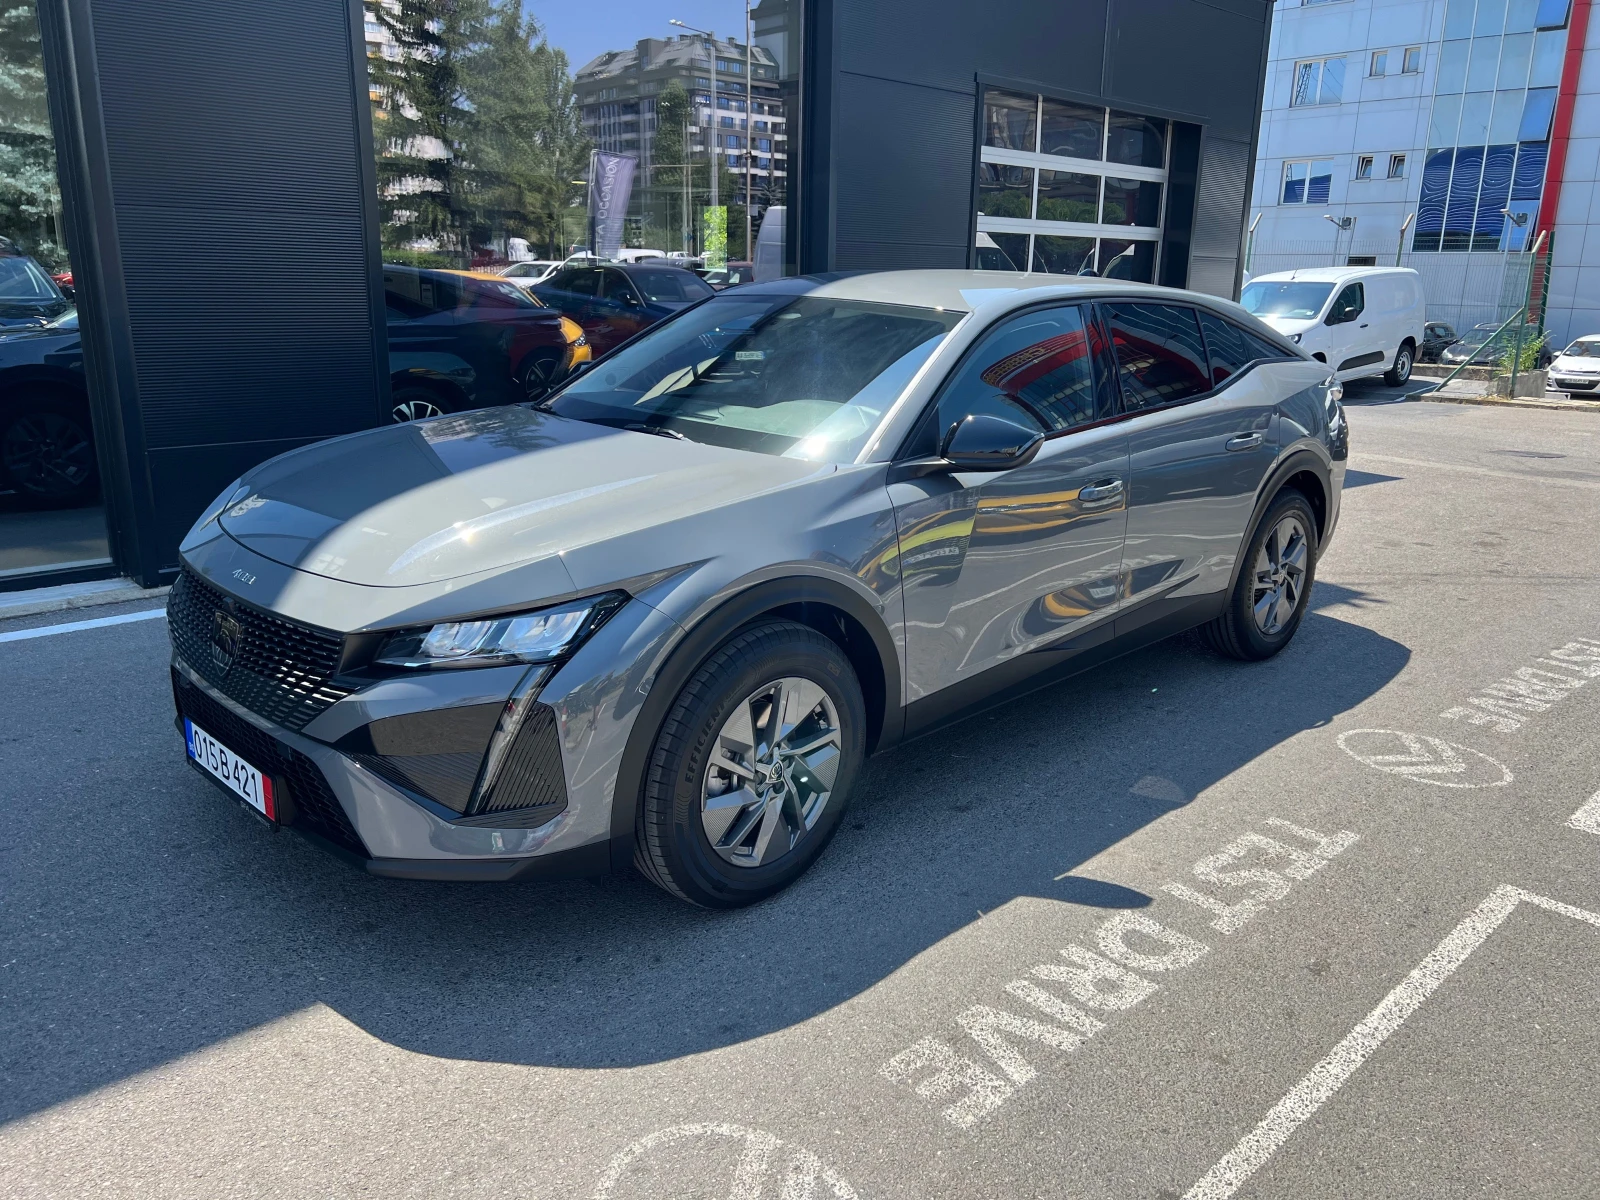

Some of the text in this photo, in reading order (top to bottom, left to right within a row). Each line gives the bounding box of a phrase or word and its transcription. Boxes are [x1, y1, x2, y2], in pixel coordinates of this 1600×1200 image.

[1439, 667, 1587, 733] DRIVE
[878, 817, 1361, 1130] TEST DRIVE
